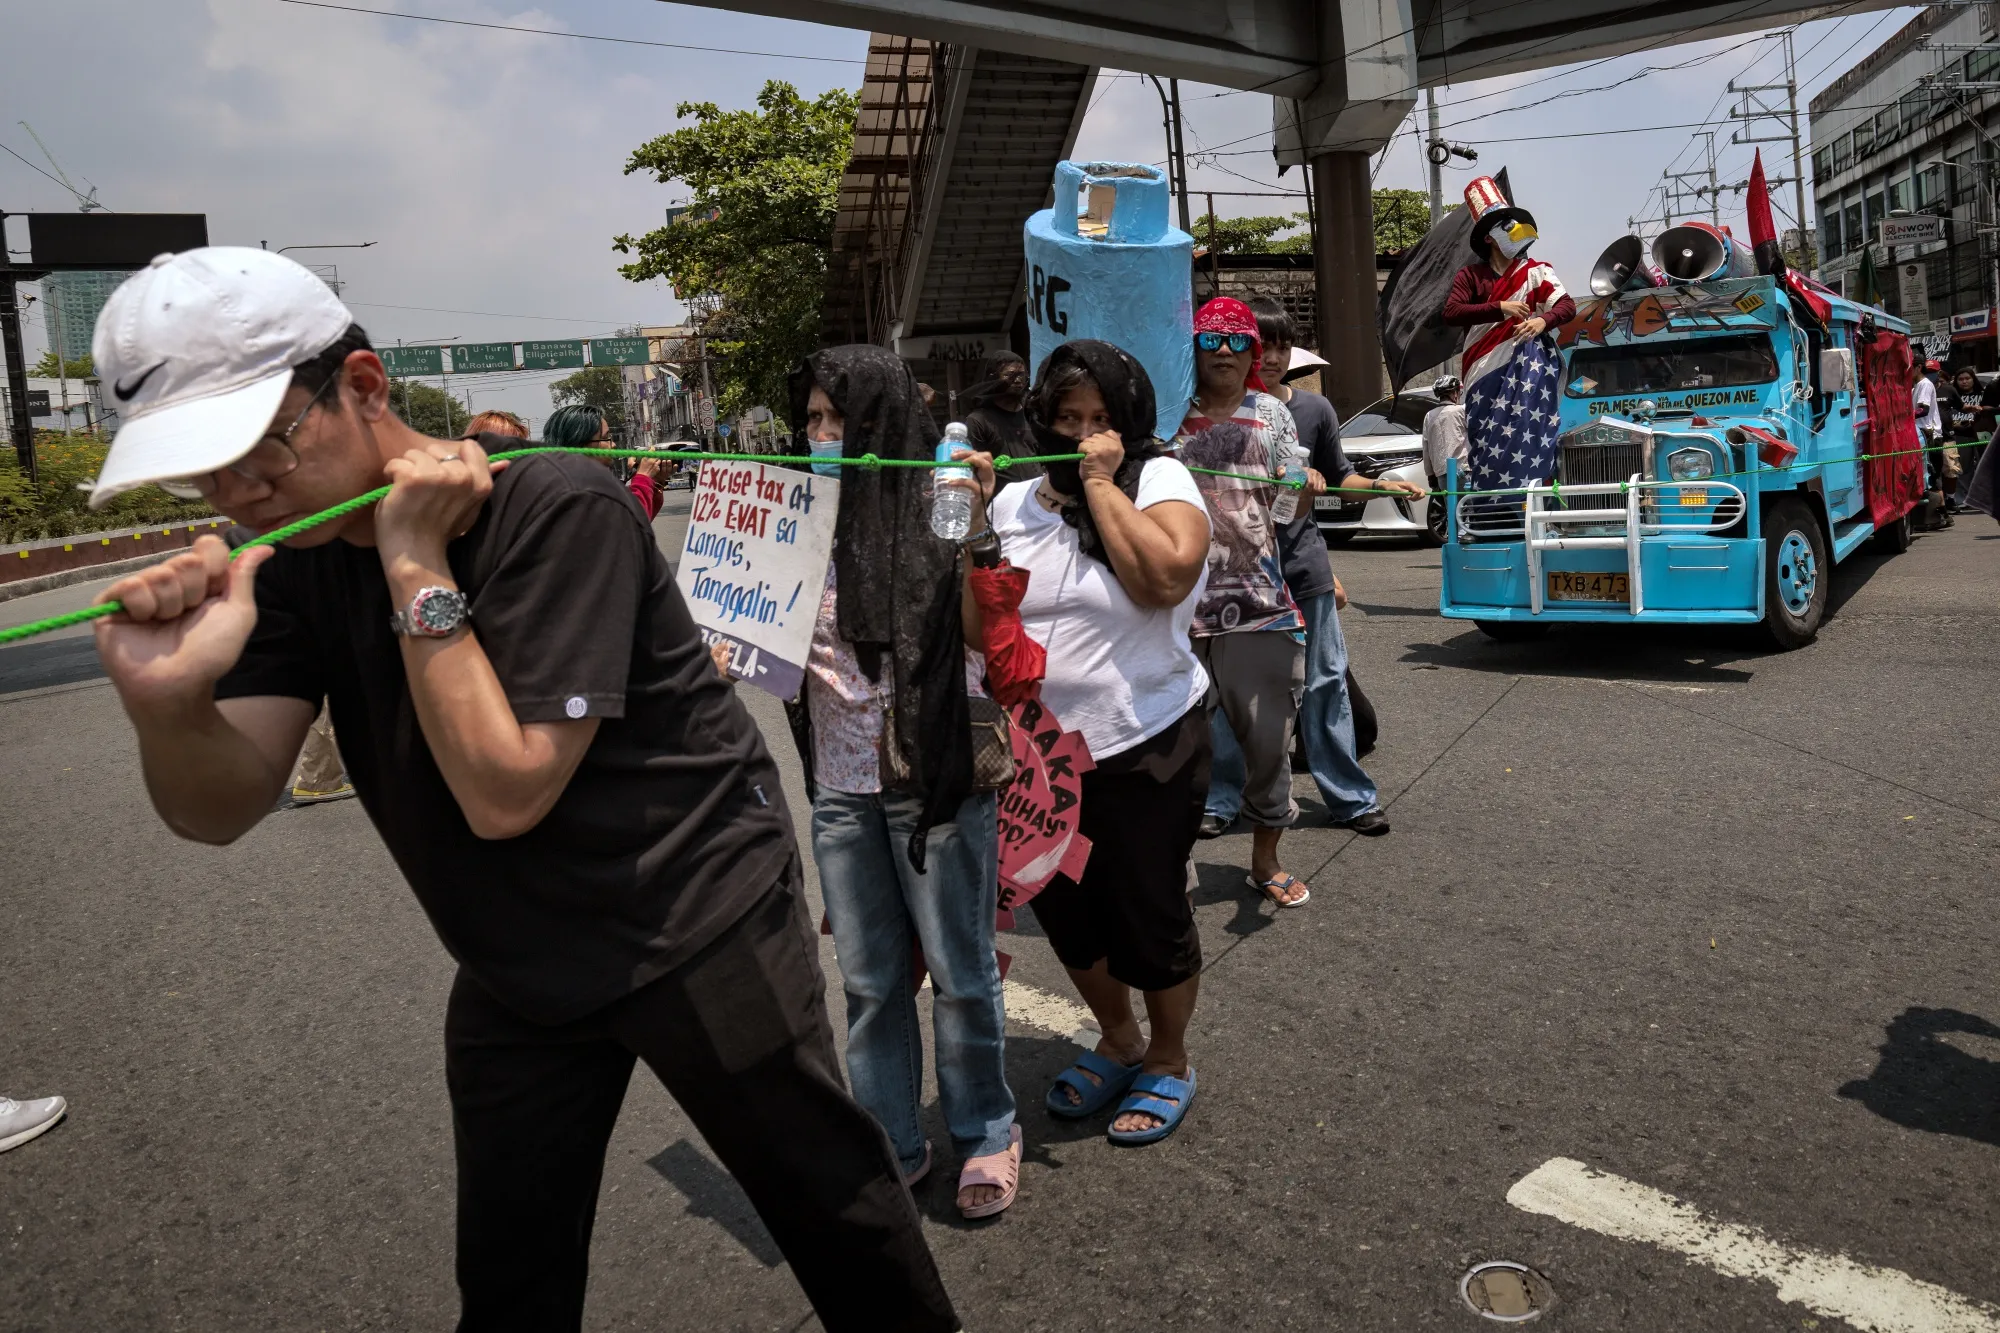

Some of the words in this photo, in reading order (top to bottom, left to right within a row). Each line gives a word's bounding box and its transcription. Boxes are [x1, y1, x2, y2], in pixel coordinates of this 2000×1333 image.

[401, 348, 436, 356] U-Turn
[472, 345, 508, 353] U-Turn
[533, 342, 573, 350] Banawe
[596, 340, 605, 348] D.
[606, 347, 635, 355] EDSA
[525, 350, 568, 358] Elliptical
[1657, 401, 1672, 409] NETA
[1685, 393, 1731, 409] QUEZON
[1734, 389, 1760, 404] AVE.
[698, 459, 752, 496] Excise
[755, 465, 786, 505] tax
[789, 477, 815, 514] at
[692, 492, 721, 522] 12%
[776, 517, 797, 545] sa
[686, 524, 751, 571] Langis,
[1550, 575, 1586, 592] TXB
[1591, 576, 1627, 593] 473
[691, 566, 803, 628] Tanggalin!
[1018, 699, 1078, 815] BAKA
